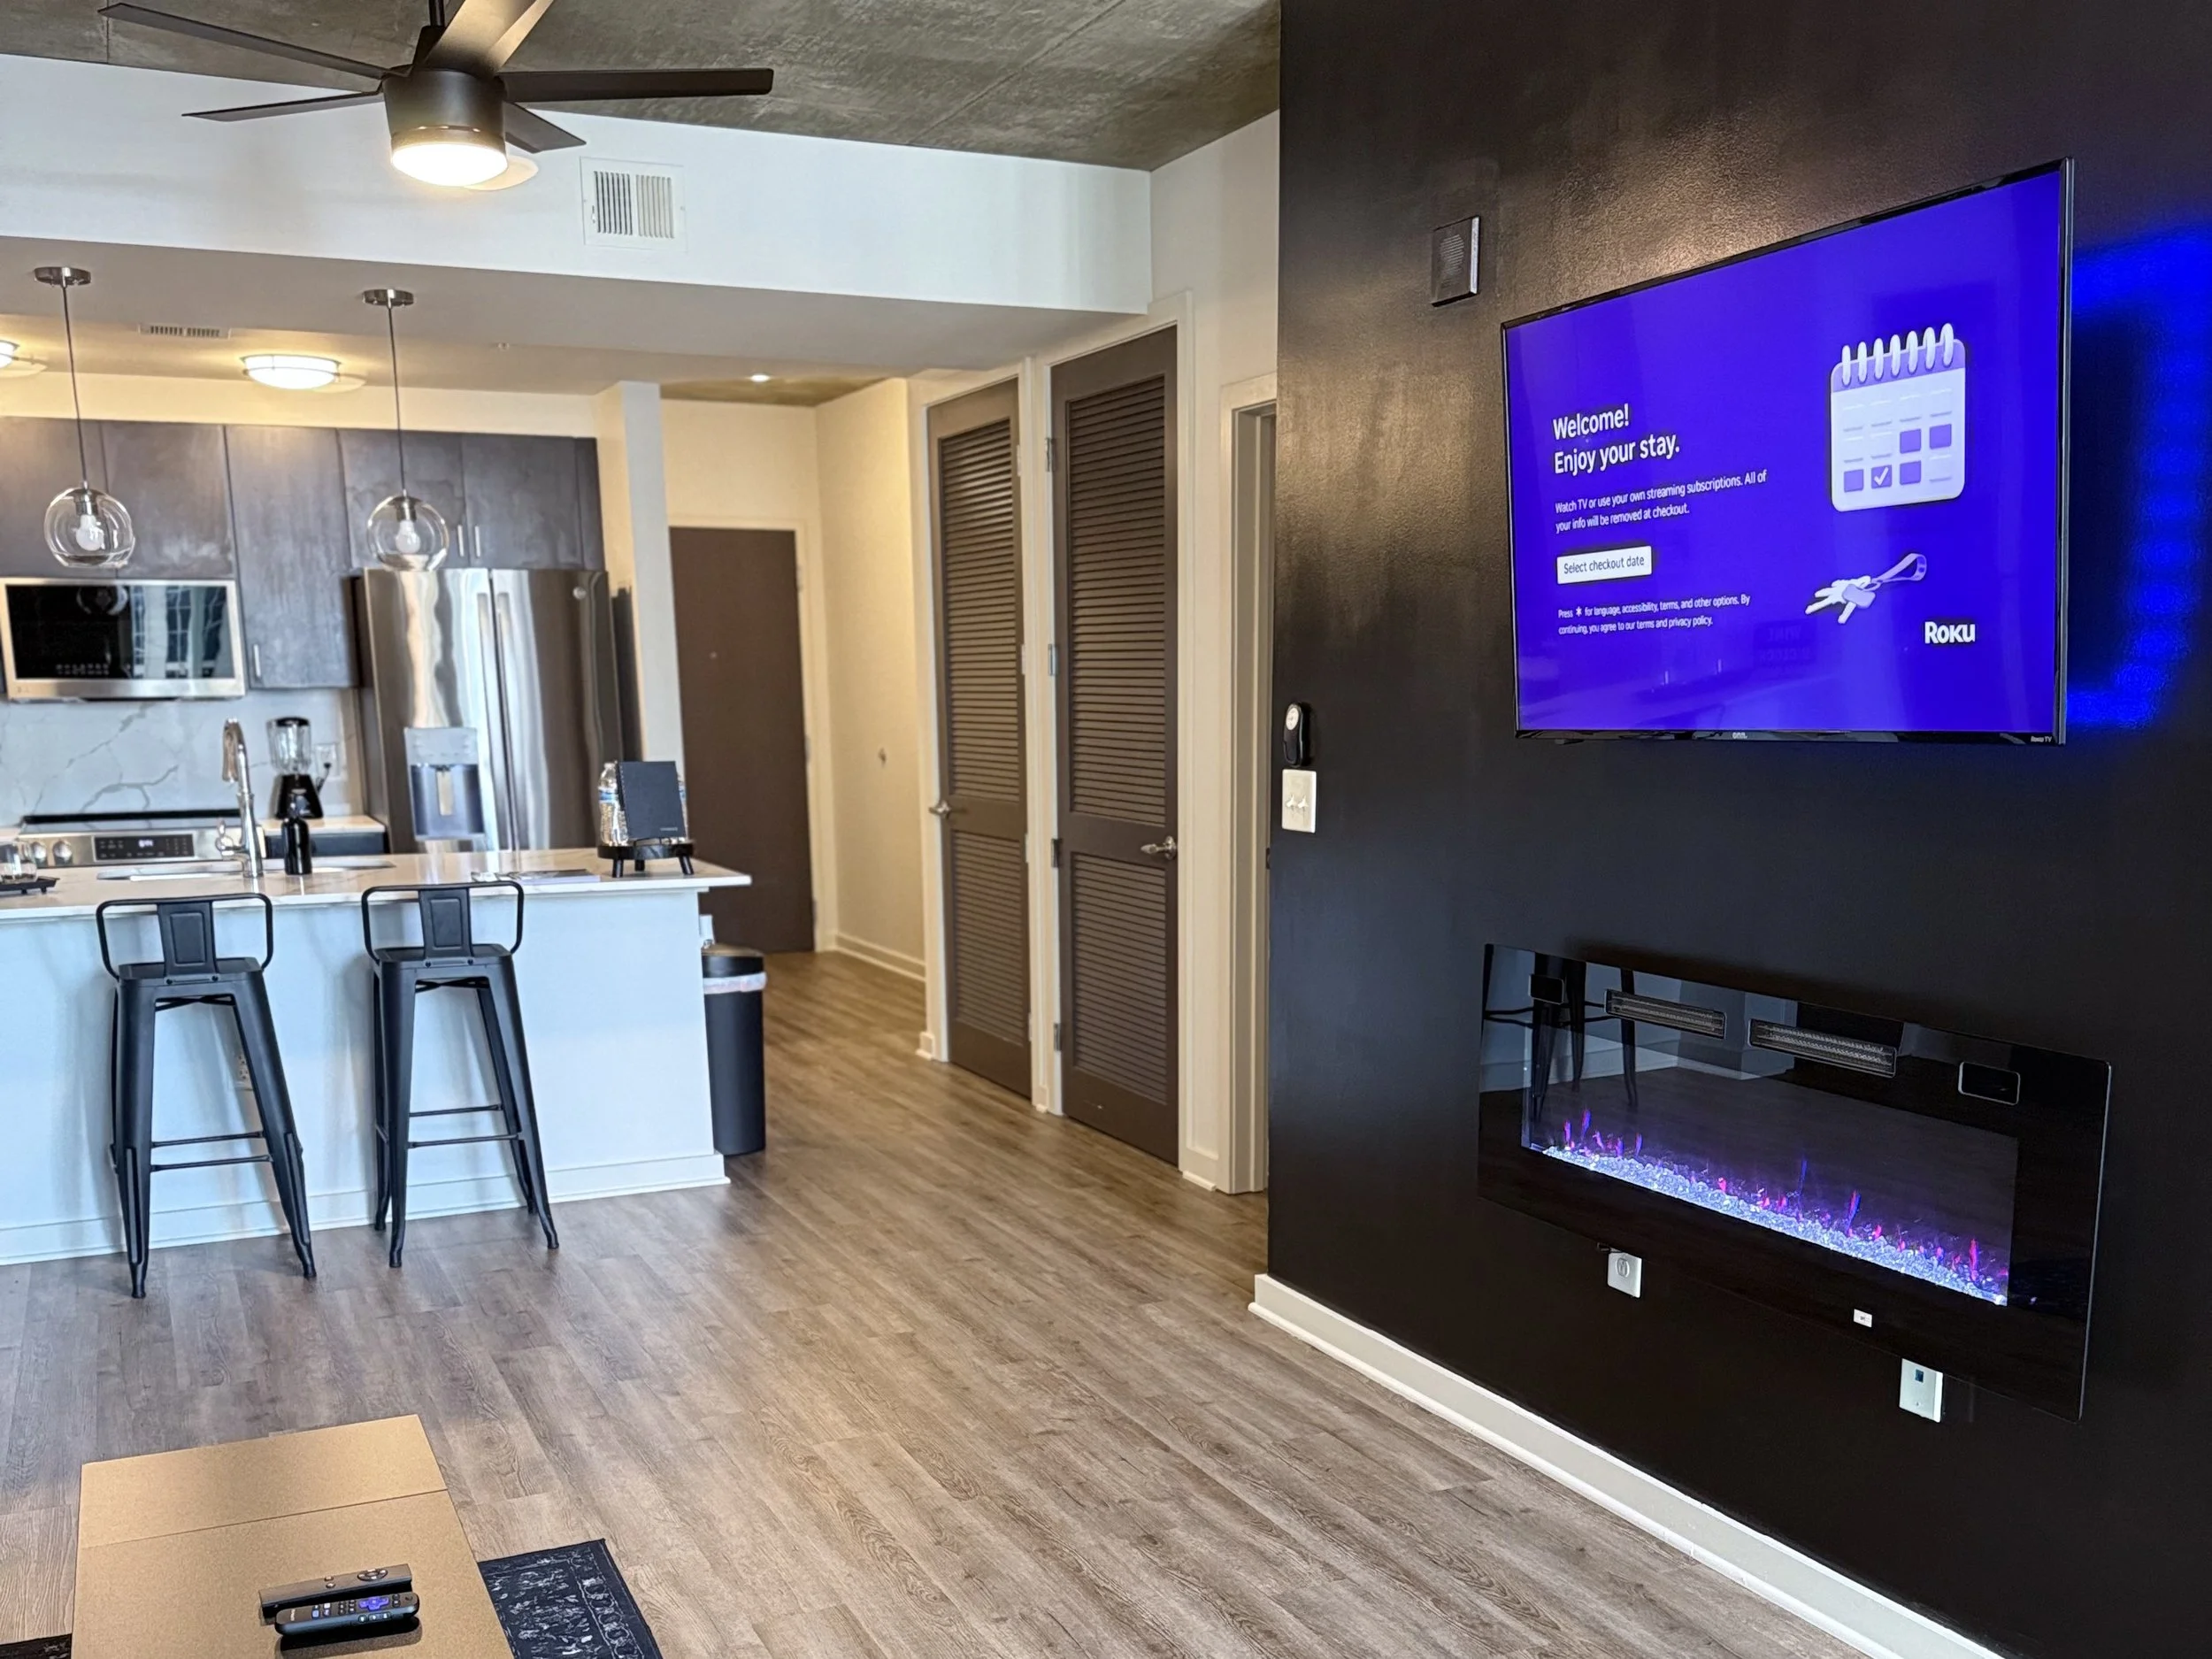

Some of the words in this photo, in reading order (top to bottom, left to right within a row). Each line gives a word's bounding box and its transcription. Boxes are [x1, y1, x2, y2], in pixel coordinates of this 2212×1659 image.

[1553, 403, 1629, 440] Welcome!
[1555, 448, 1596, 476] Enjoy
[1600, 442, 1636, 472] your
[1640, 434, 1679, 459] stay.
[1555, 500, 1577, 514] Watch
[1578, 498, 1588, 510] TV
[1588, 498, 1598, 509] or
[1597, 496, 1610, 507] use
[1611, 493, 1628, 508] your
[1629, 490, 1646, 503] own
[1647, 483, 1686, 500] streaming
[1686, 476, 1743, 492] subscriptions.
[1744, 471, 1756, 486] All
[1757, 469, 1767, 483] of
[1555, 520, 1571, 534] your
[1572, 517, 1586, 530] info
[1586, 515, 1599, 527] will
[1600, 514, 1609, 526] be
[1609, 509, 1642, 524] removed
[1643, 509, 1652, 520] at
[1652, 503, 1690, 518] checkout.
[1563, 561, 1587, 575] Select
[1588, 557, 1625, 572] checkout
[1626, 556, 1645, 567] date
[1558, 609, 1573, 618] Press
[1585, 606, 1594, 617] for
[1621, 602, 1659, 612] accessibility,
[1680, 598, 1694, 609] and
[1694, 597, 1712, 608] other
[1712, 595, 1740, 608] options.
[1740, 594, 1751, 606] By
[1588, 625, 1600, 635] you
[1600, 623, 1617, 634] agree
[1617, 621, 1624, 631] to
[1625, 621, 1636, 630] our
[1636, 619, 1655, 630] terms
[1655, 618, 1668, 628] and
[1668, 617, 1692, 629] privacy
[1692, 615, 1713, 627] policy.
